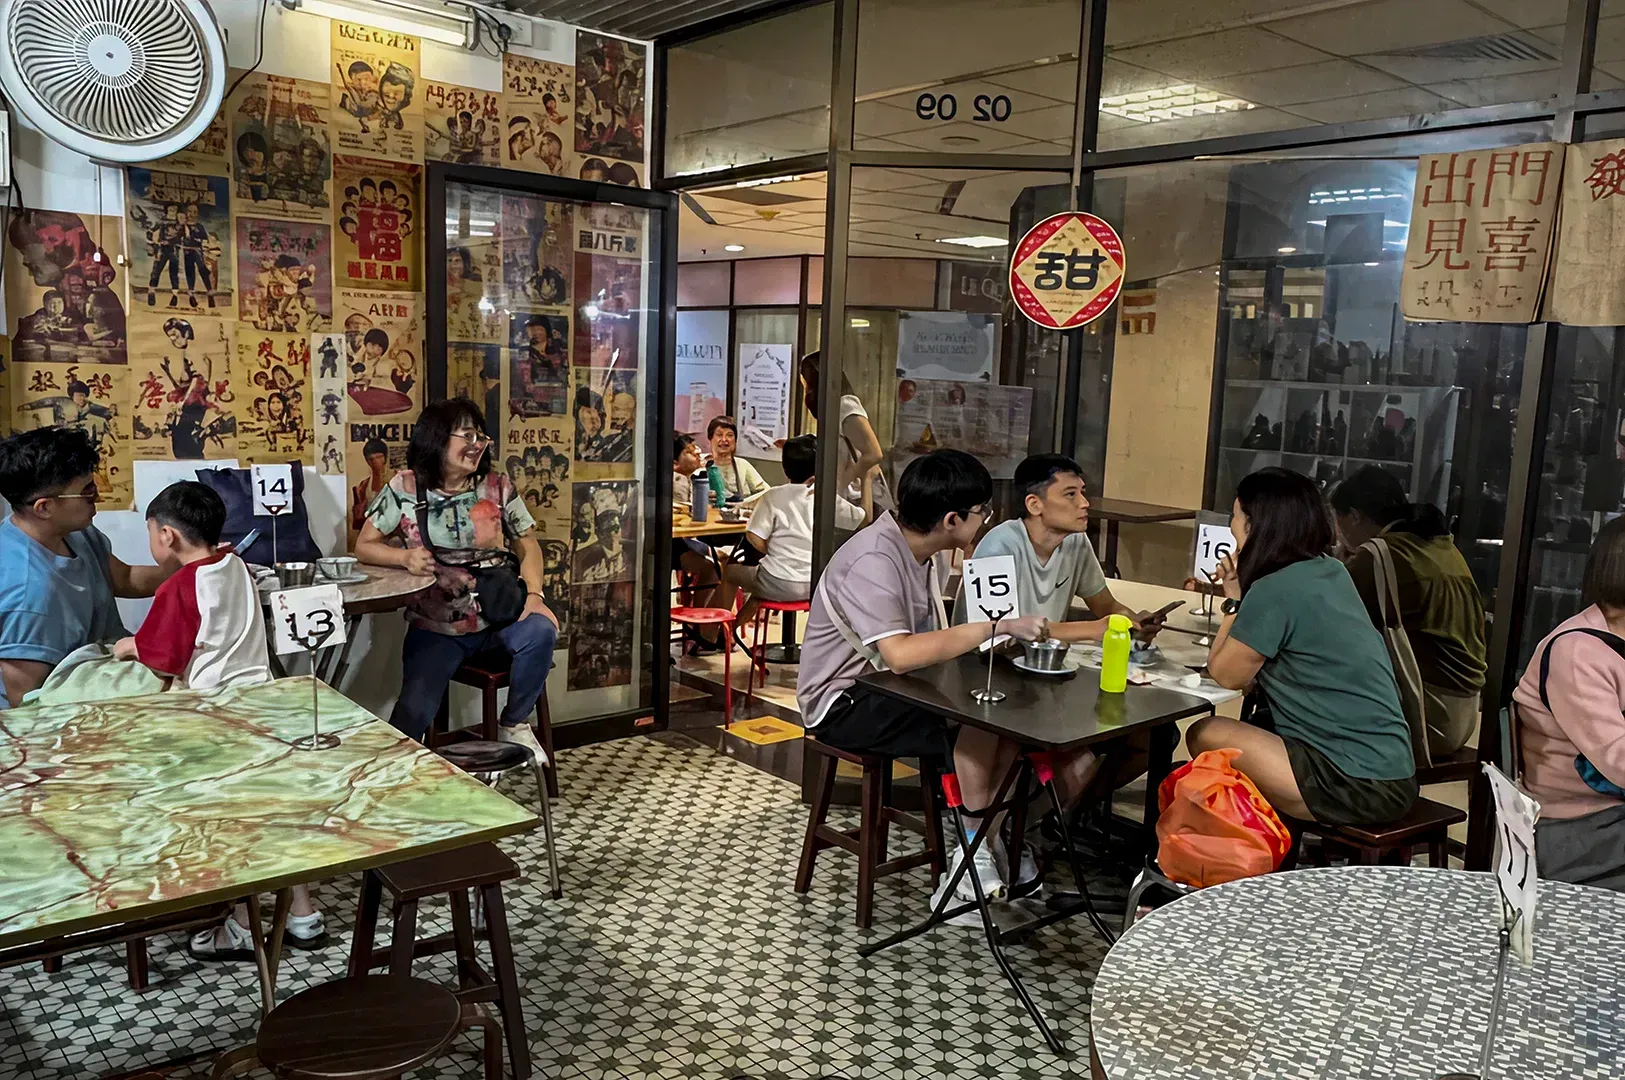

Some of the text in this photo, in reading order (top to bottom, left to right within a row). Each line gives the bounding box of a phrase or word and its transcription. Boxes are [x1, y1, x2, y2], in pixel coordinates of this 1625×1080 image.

[1422, 150, 1554, 208] 出門
[1413, 216, 1540, 272] 見喜
[1034, 247, 1107, 290] 甜
[257, 478, 287, 496] 14
[1203, 541, 1231, 560] 16
[971, 574, 1010, 599] 15
[285, 609, 335, 637] 13
